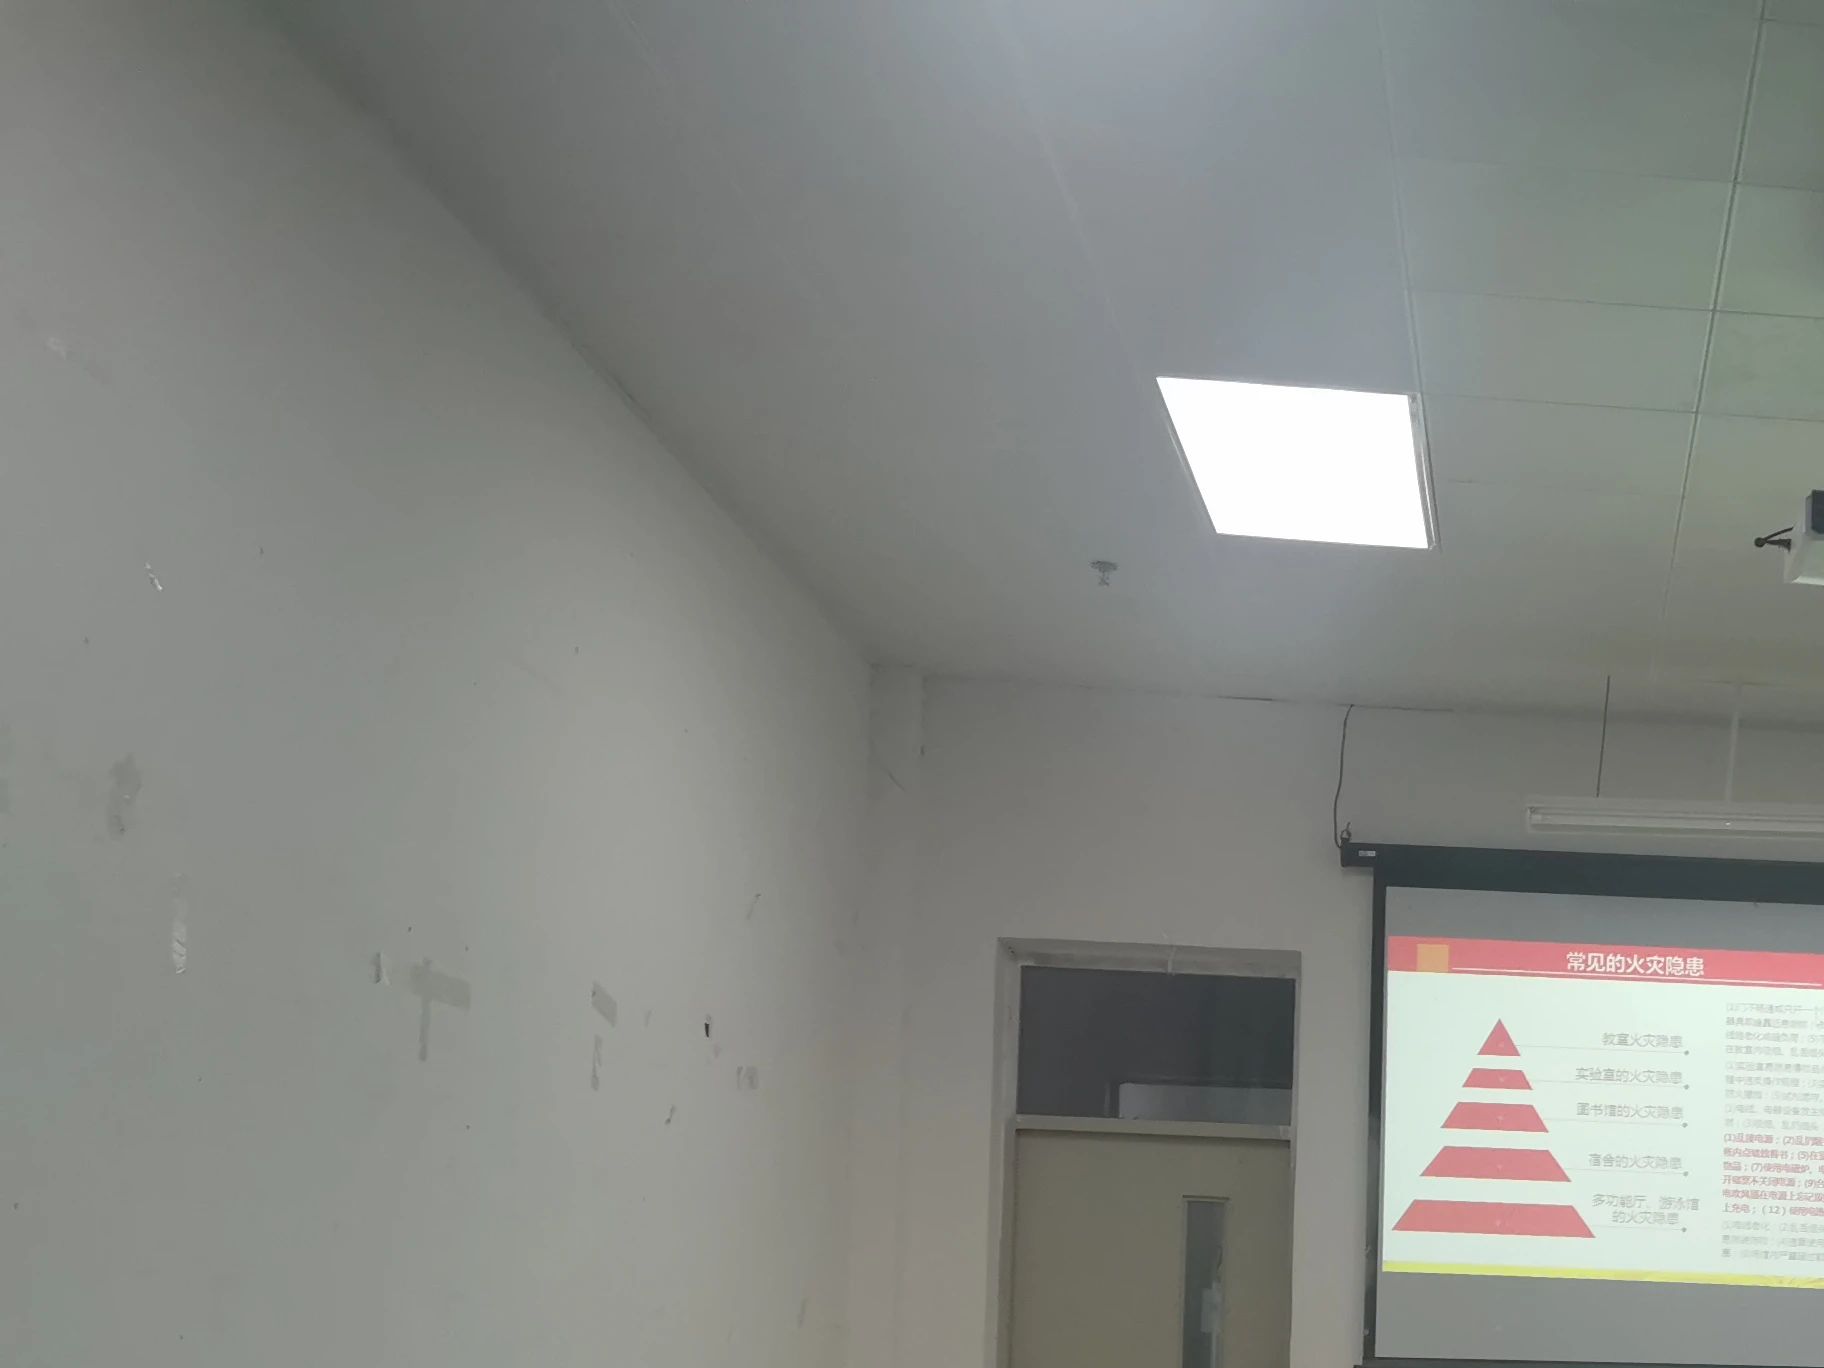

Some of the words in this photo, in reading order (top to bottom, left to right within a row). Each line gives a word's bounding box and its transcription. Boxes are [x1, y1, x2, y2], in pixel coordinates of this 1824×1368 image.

[1567, 952, 1705, 977] 常见的火灾隐患
[1576, 1067, 1682, 1084] 实验室的火灾隐患
[1577, 1102, 1682, 1119] 图书馆的火灾隐患
[1588, 1153, 1682, 1170] 宿舍的火灾隐患
[1612, 1210, 1680, 1225] 的火灾隐患
